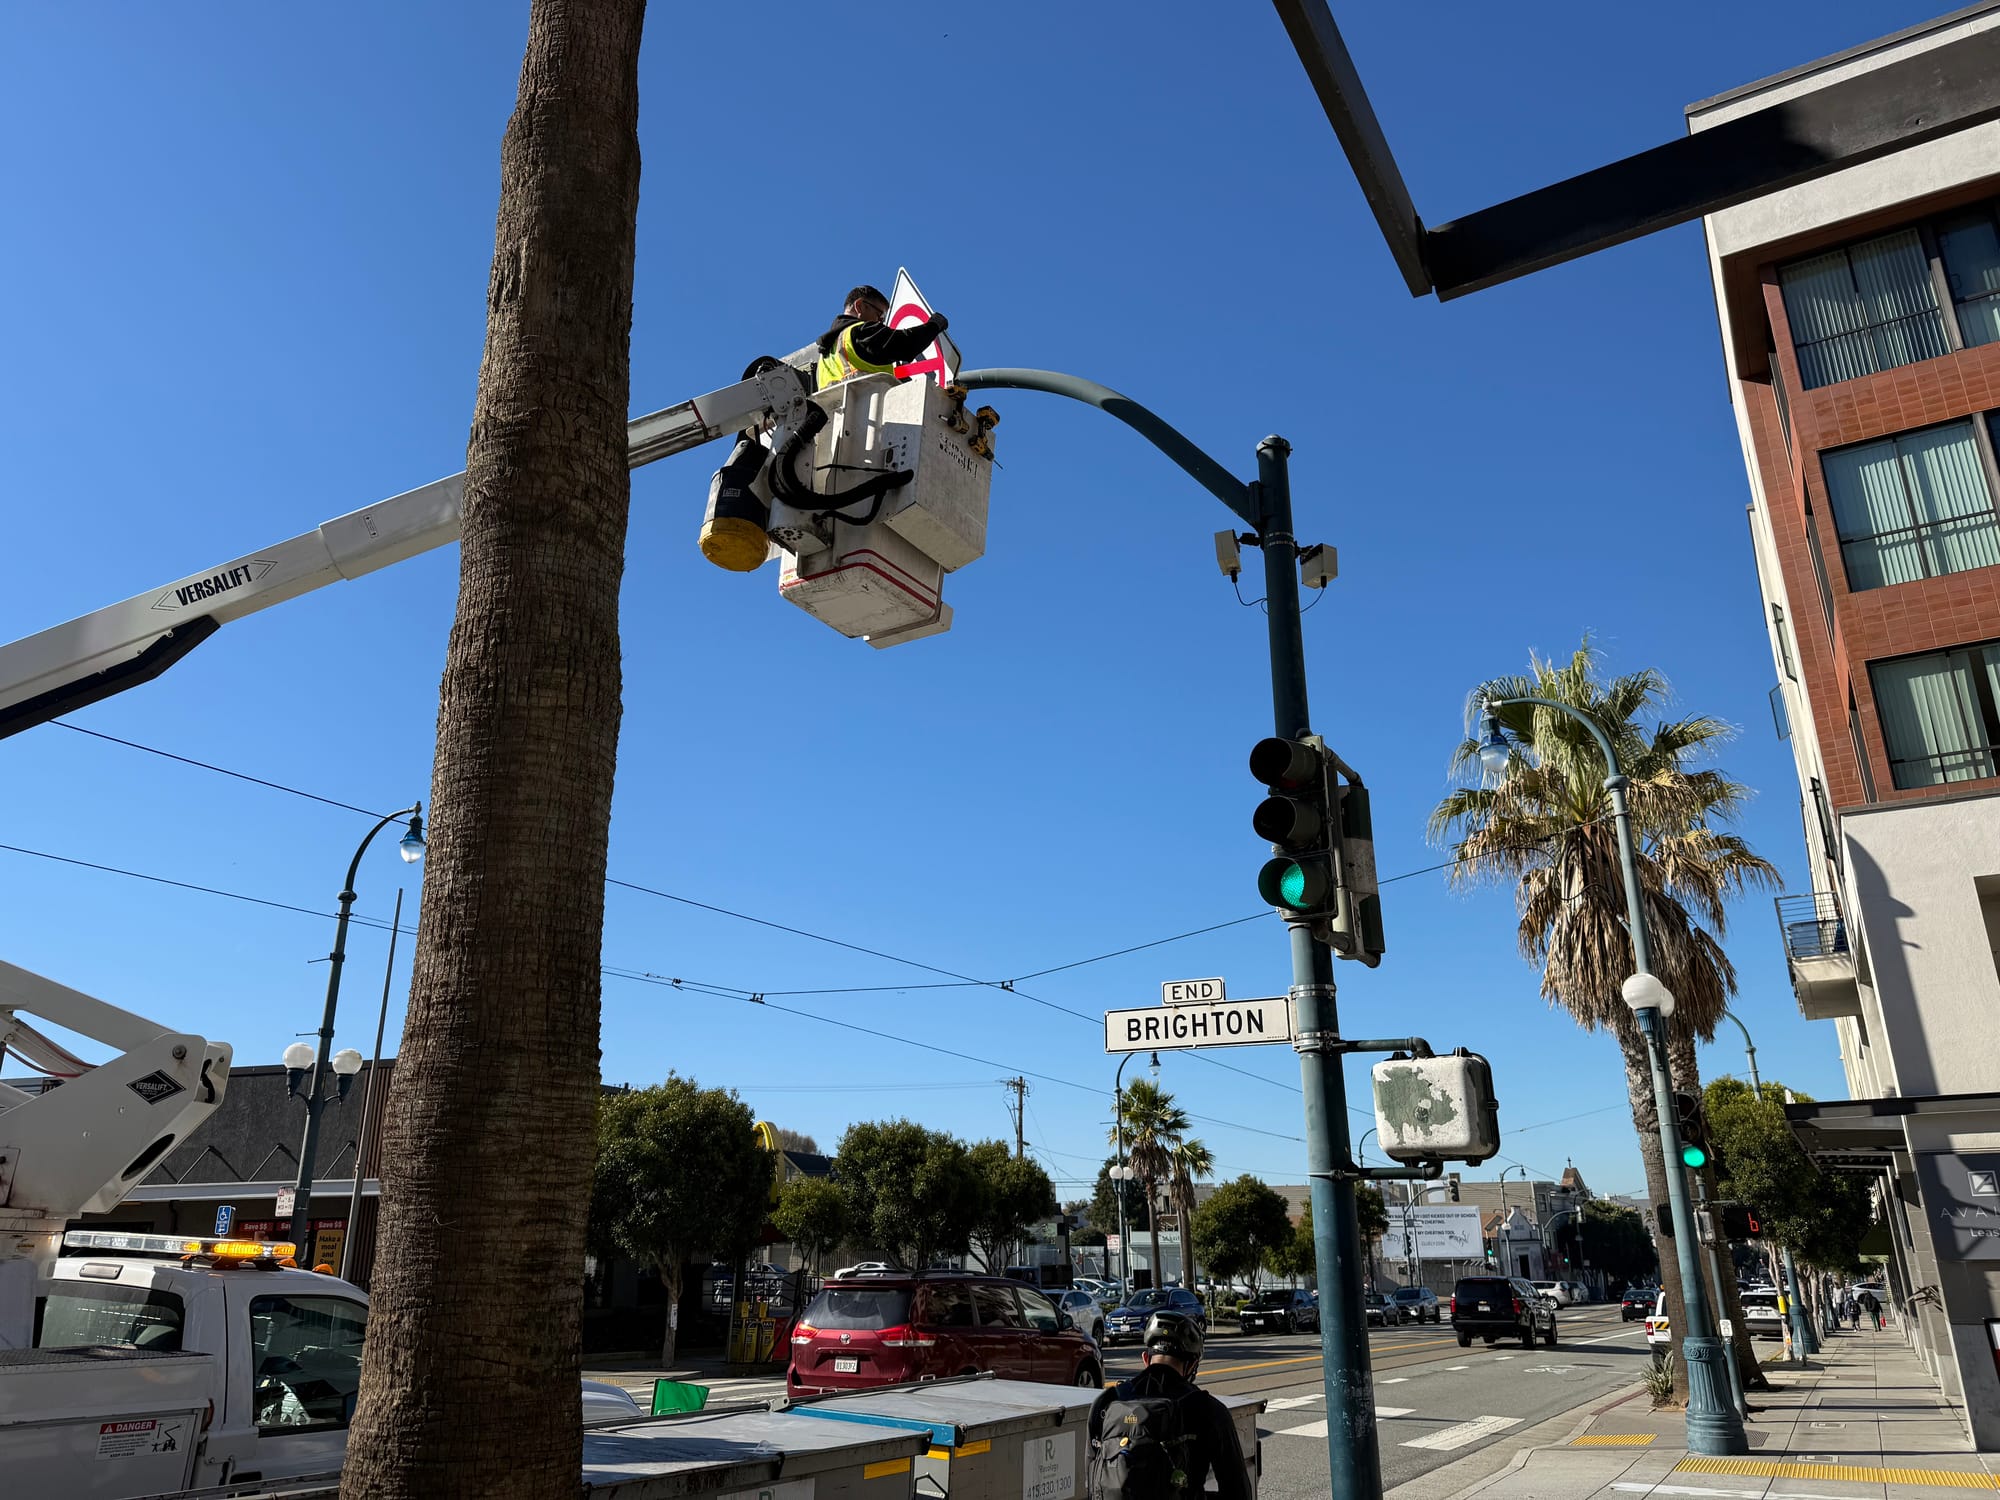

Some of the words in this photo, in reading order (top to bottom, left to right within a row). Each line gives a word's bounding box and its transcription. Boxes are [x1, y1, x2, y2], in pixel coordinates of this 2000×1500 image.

[175, 564, 253, 607] VERSALIFT
[1171, 982, 1214, 1001] END
[1127, 1008, 1265, 1042] BRIGHTON
[135, 1081, 168, 1091] VERSALIFT
[1970, 1228, 2000, 1237] Leas
[116, 1421, 153, 1432] DANGER
[1027, 1475, 1072, 1498] 415.330.1300
